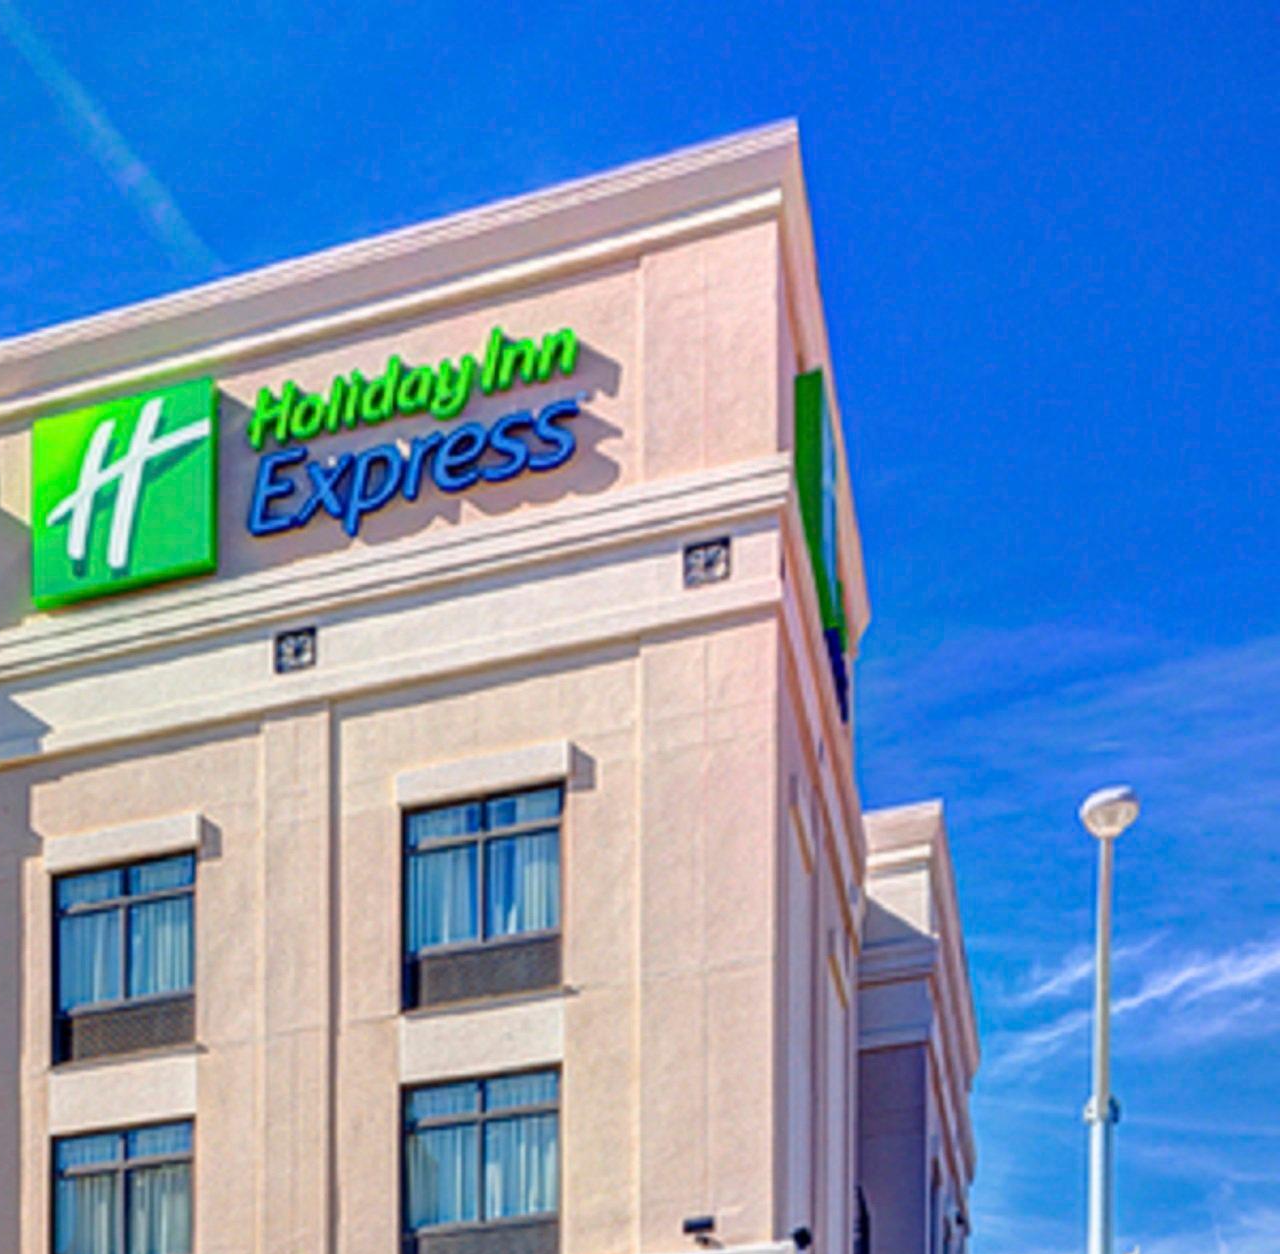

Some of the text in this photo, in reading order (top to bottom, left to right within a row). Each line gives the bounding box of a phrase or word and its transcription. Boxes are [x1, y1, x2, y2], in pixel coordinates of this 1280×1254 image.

[246, 326, 579, 450] Holiday Inn
[246, 399, 580, 537] Express
